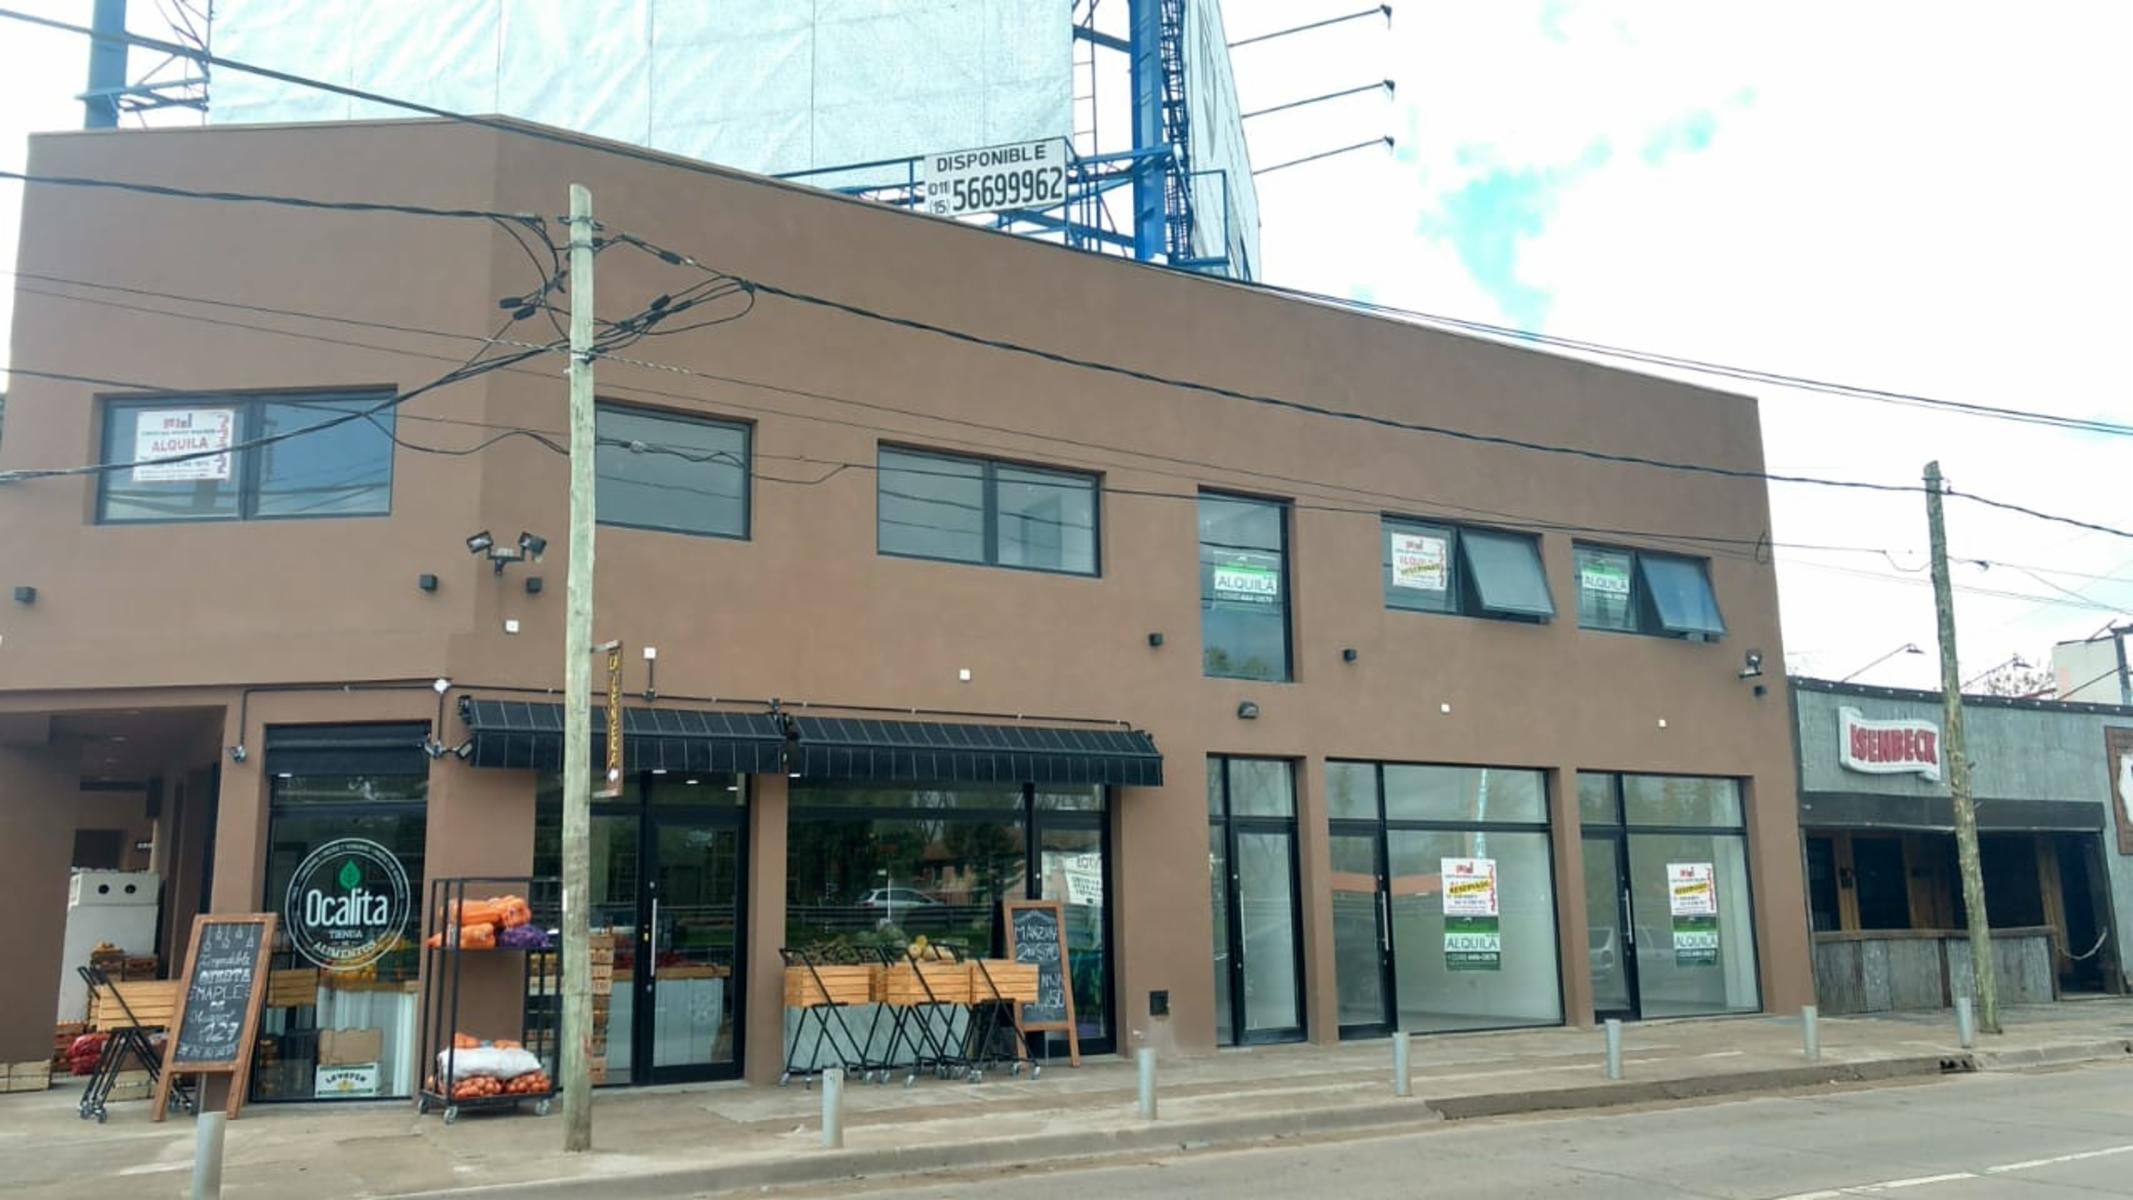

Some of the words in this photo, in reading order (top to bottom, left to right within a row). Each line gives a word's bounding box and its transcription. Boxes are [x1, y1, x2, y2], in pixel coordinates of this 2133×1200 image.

[937, 144, 1047, 172] DISPONIBLE
[953, 166, 1063, 211] 56699962
[151, 436, 209, 452] ALQUILA
[1217, 575, 1275, 590] ALQUILA
[1583, 575, 1627, 590] ALQUILA
[1850, 723, 1937, 765] ISENBECK
[305, 887, 389, 928] Ocalita
[1447, 936, 1499, 949] ALQUILA
[1675, 933, 1717, 947] ALQUILA
[313, 940, 377, 959] ALIMENTOS
[195, 983, 244, 1001] MAPLE
